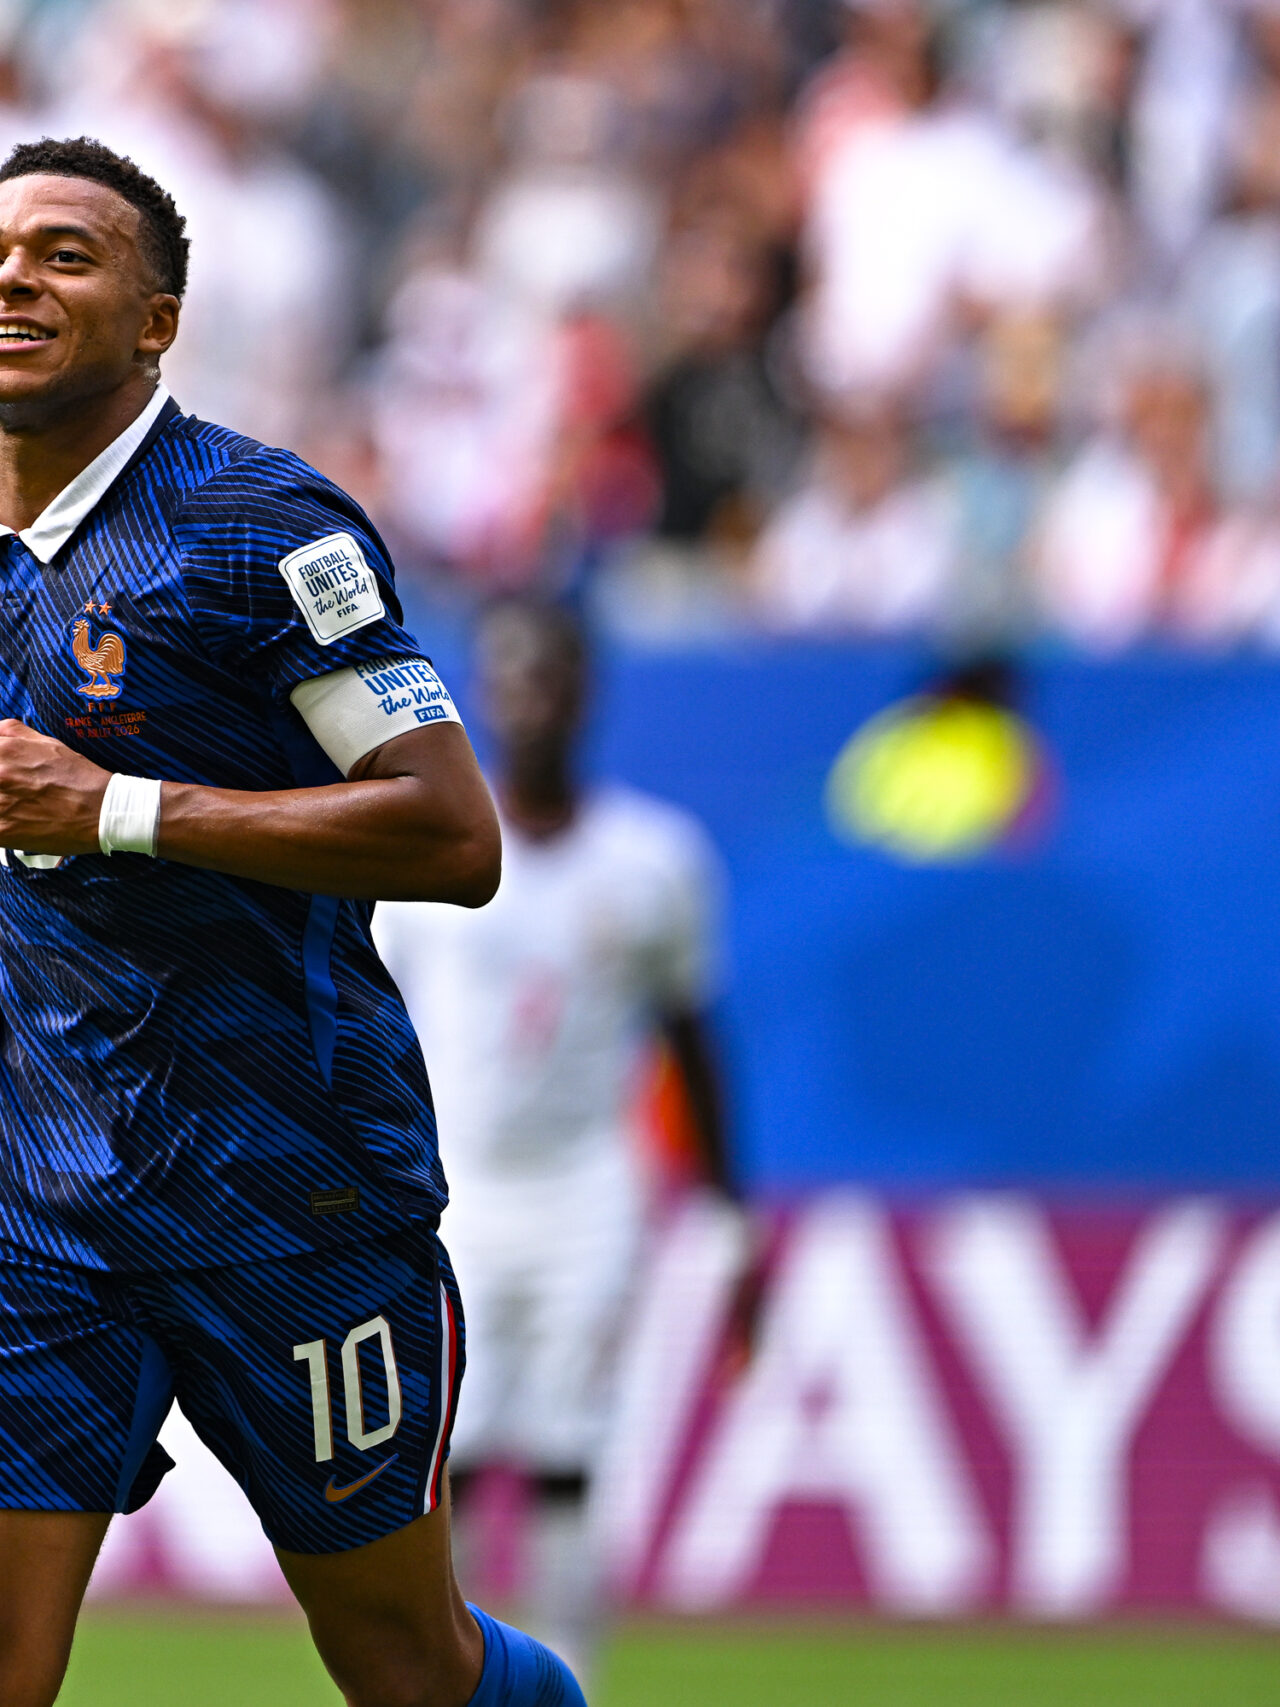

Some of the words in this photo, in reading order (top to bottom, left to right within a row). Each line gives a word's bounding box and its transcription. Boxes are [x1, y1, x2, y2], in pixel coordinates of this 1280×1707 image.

[298, 549, 350, 580] FOOTBALL
[305, 561, 359, 597] UNITES
[313, 597, 335, 616] the
[333, 577, 369, 605] World
[337, 603, 359, 618] FIFA
[364, 664, 439, 695] UNITES
[378, 695, 412, 715] the
[416, 706, 445, 722] FIFA
[114, 724, 140, 737] 2026
[293, 1314, 403, 1463] 10
